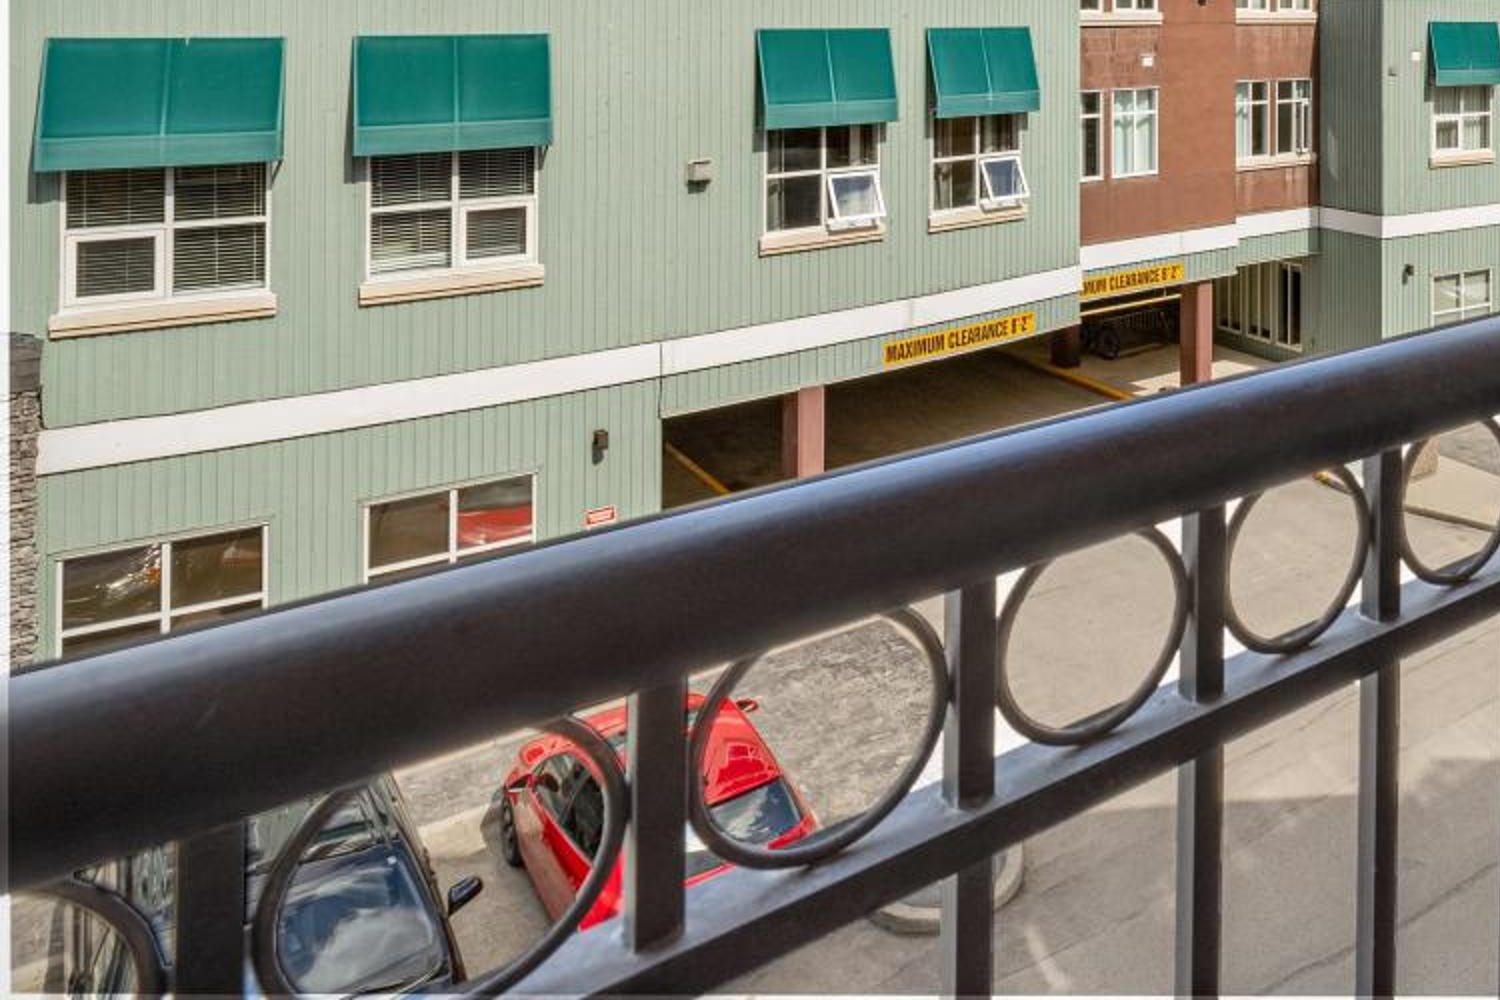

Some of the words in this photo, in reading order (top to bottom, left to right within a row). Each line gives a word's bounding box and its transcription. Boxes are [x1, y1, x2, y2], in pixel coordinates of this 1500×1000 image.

[1109, 267, 1160, 292] CLEARANCE
[885, 334, 945, 363] MAXIMUM
[947, 319, 1009, 348] CLEARANCE
